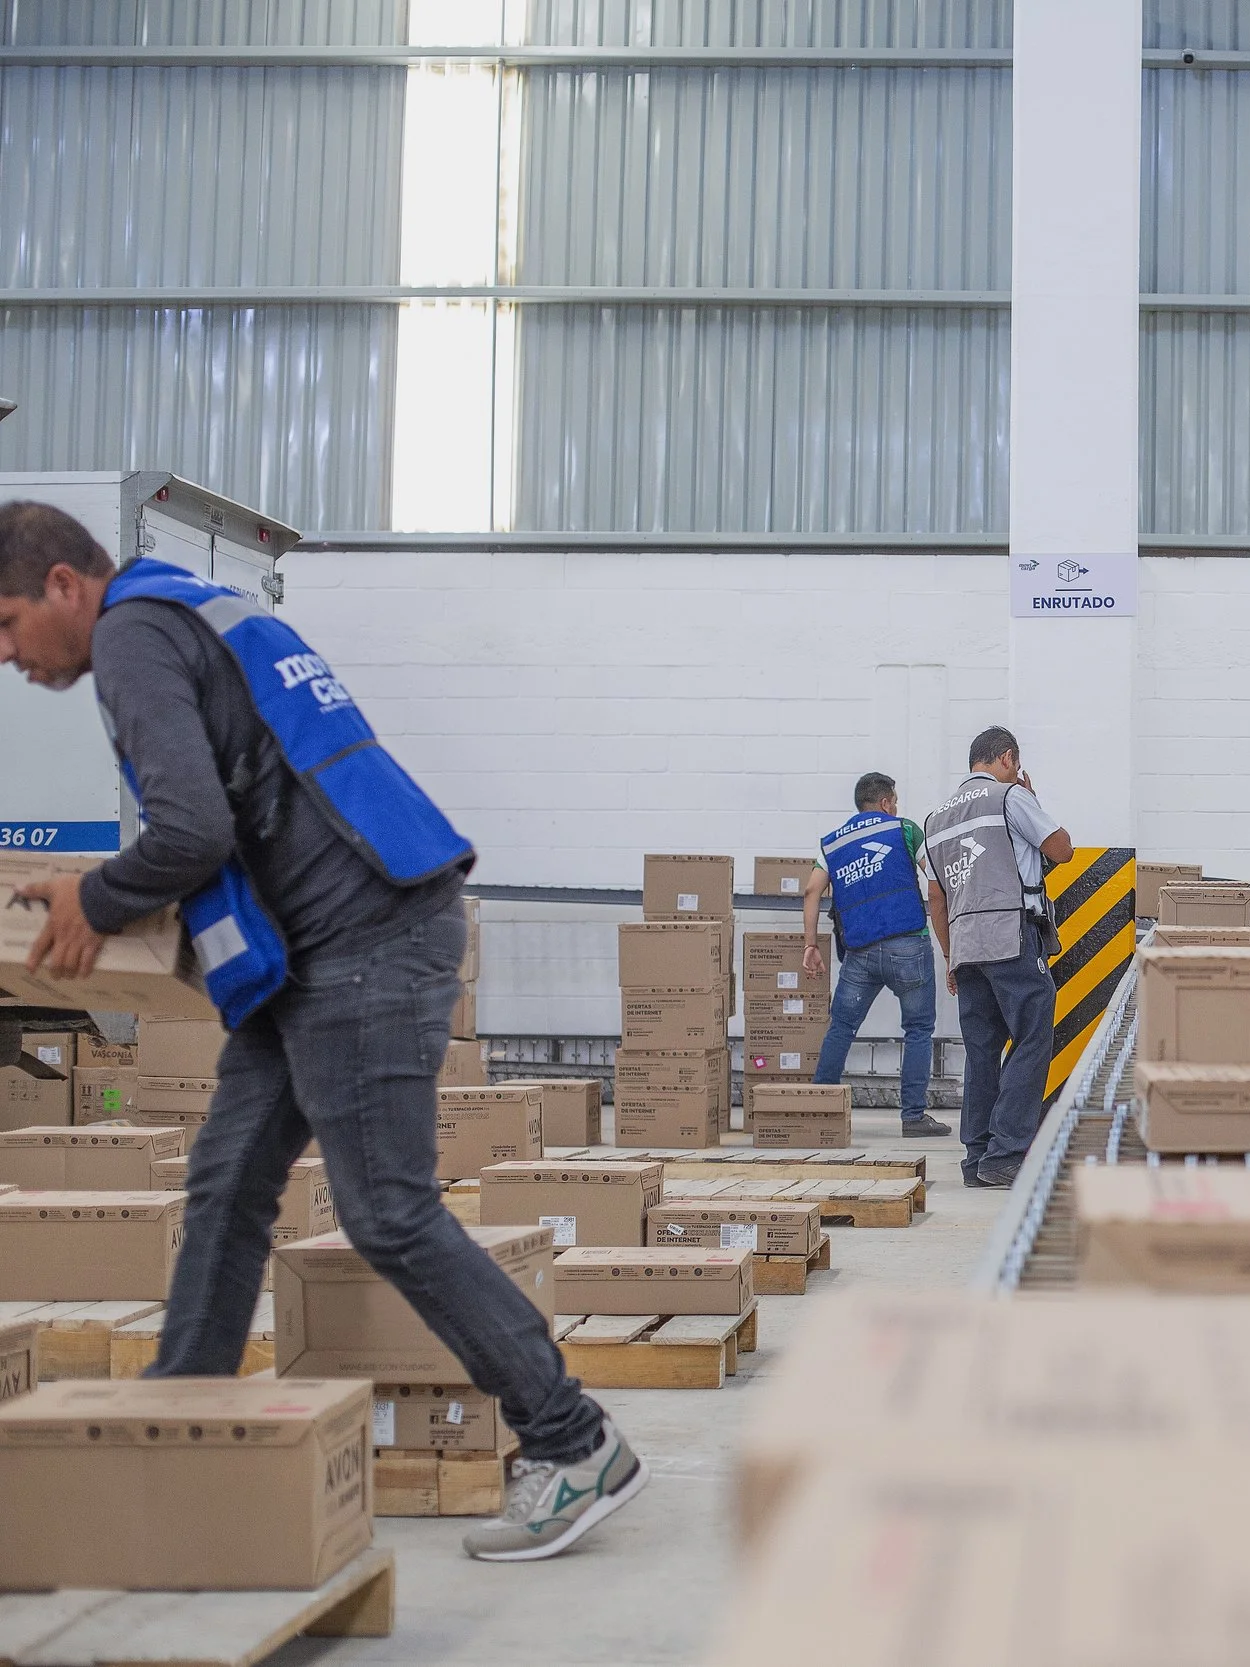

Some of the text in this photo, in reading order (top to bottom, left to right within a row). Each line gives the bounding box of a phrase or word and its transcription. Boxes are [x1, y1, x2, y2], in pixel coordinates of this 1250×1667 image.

[1032, 596, 1115, 609] ENRUTADO
[0, 828, 58, 847] 36 07
[836, 816, 882, 838] HELPER
[836, 853, 870, 880] movi
[844, 861, 883, 885] carga
[170, 1226, 184, 1250] AV
[324, 1443, 361, 1495] AVON
